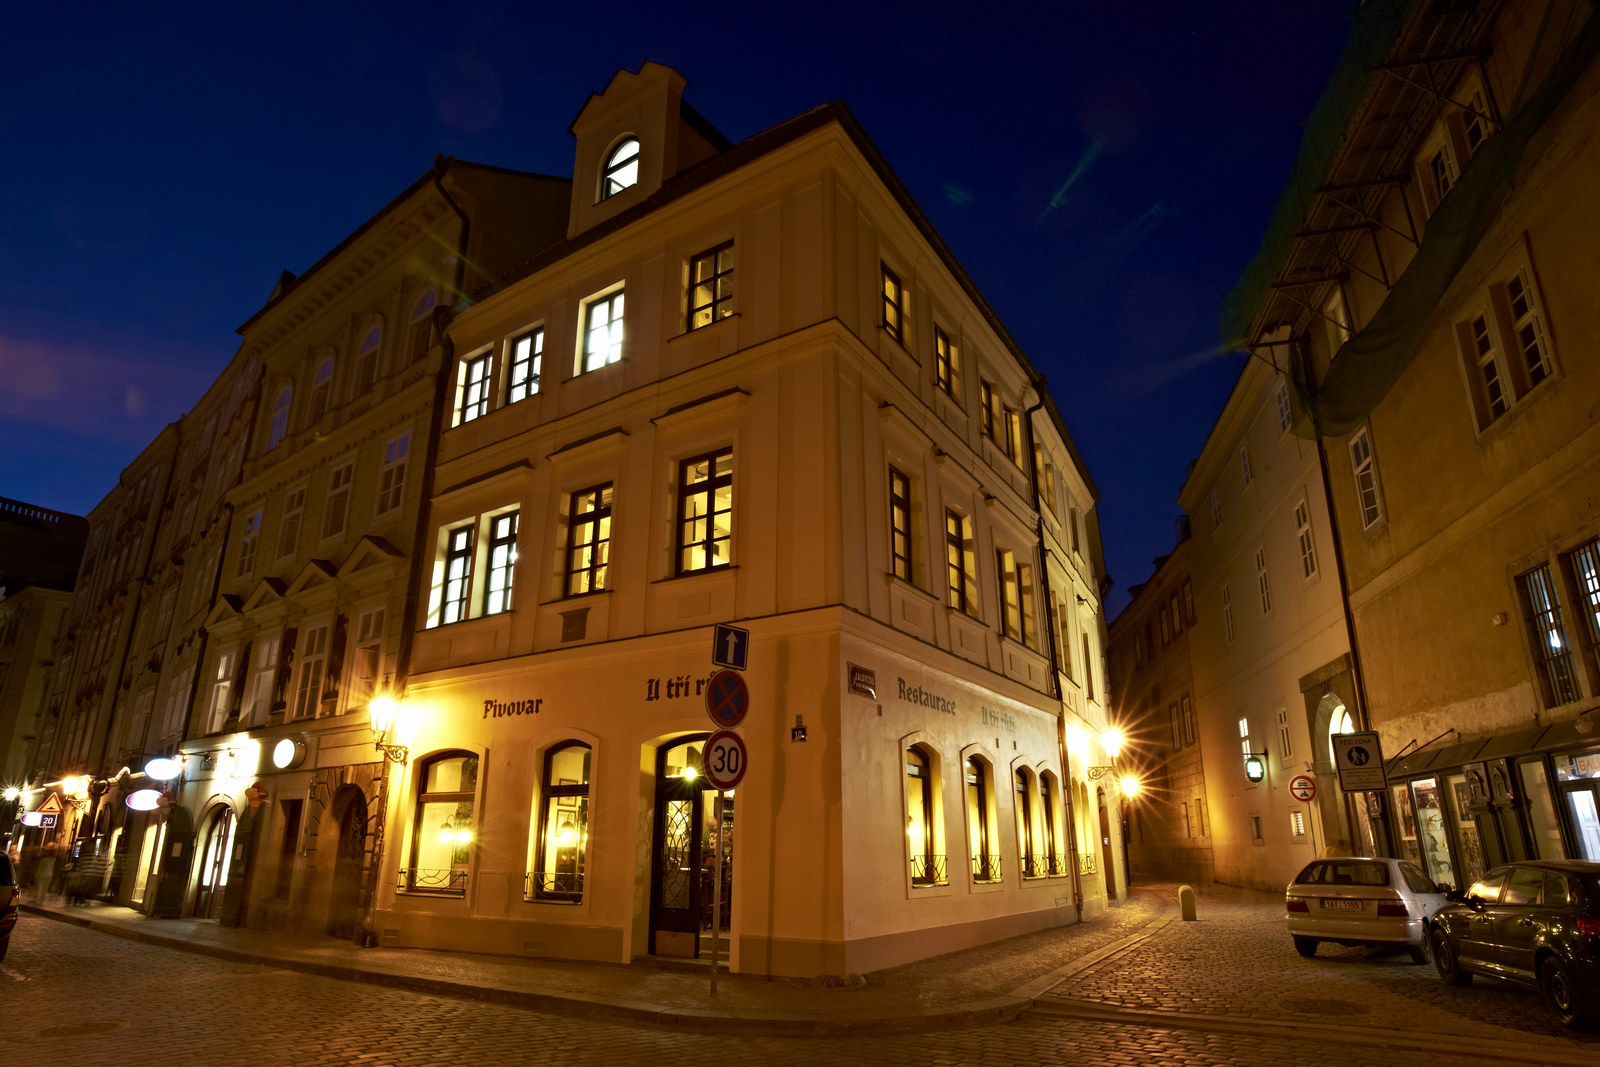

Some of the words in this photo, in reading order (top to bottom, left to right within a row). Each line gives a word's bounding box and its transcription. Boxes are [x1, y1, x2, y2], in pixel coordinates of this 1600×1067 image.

[646, 678, 660, 701] U
[666, 675, 691, 699] tří
[897, 677, 956, 716] Restaurace
[483, 698, 543, 719] Pivovar
[713, 744, 740, 774] 30
